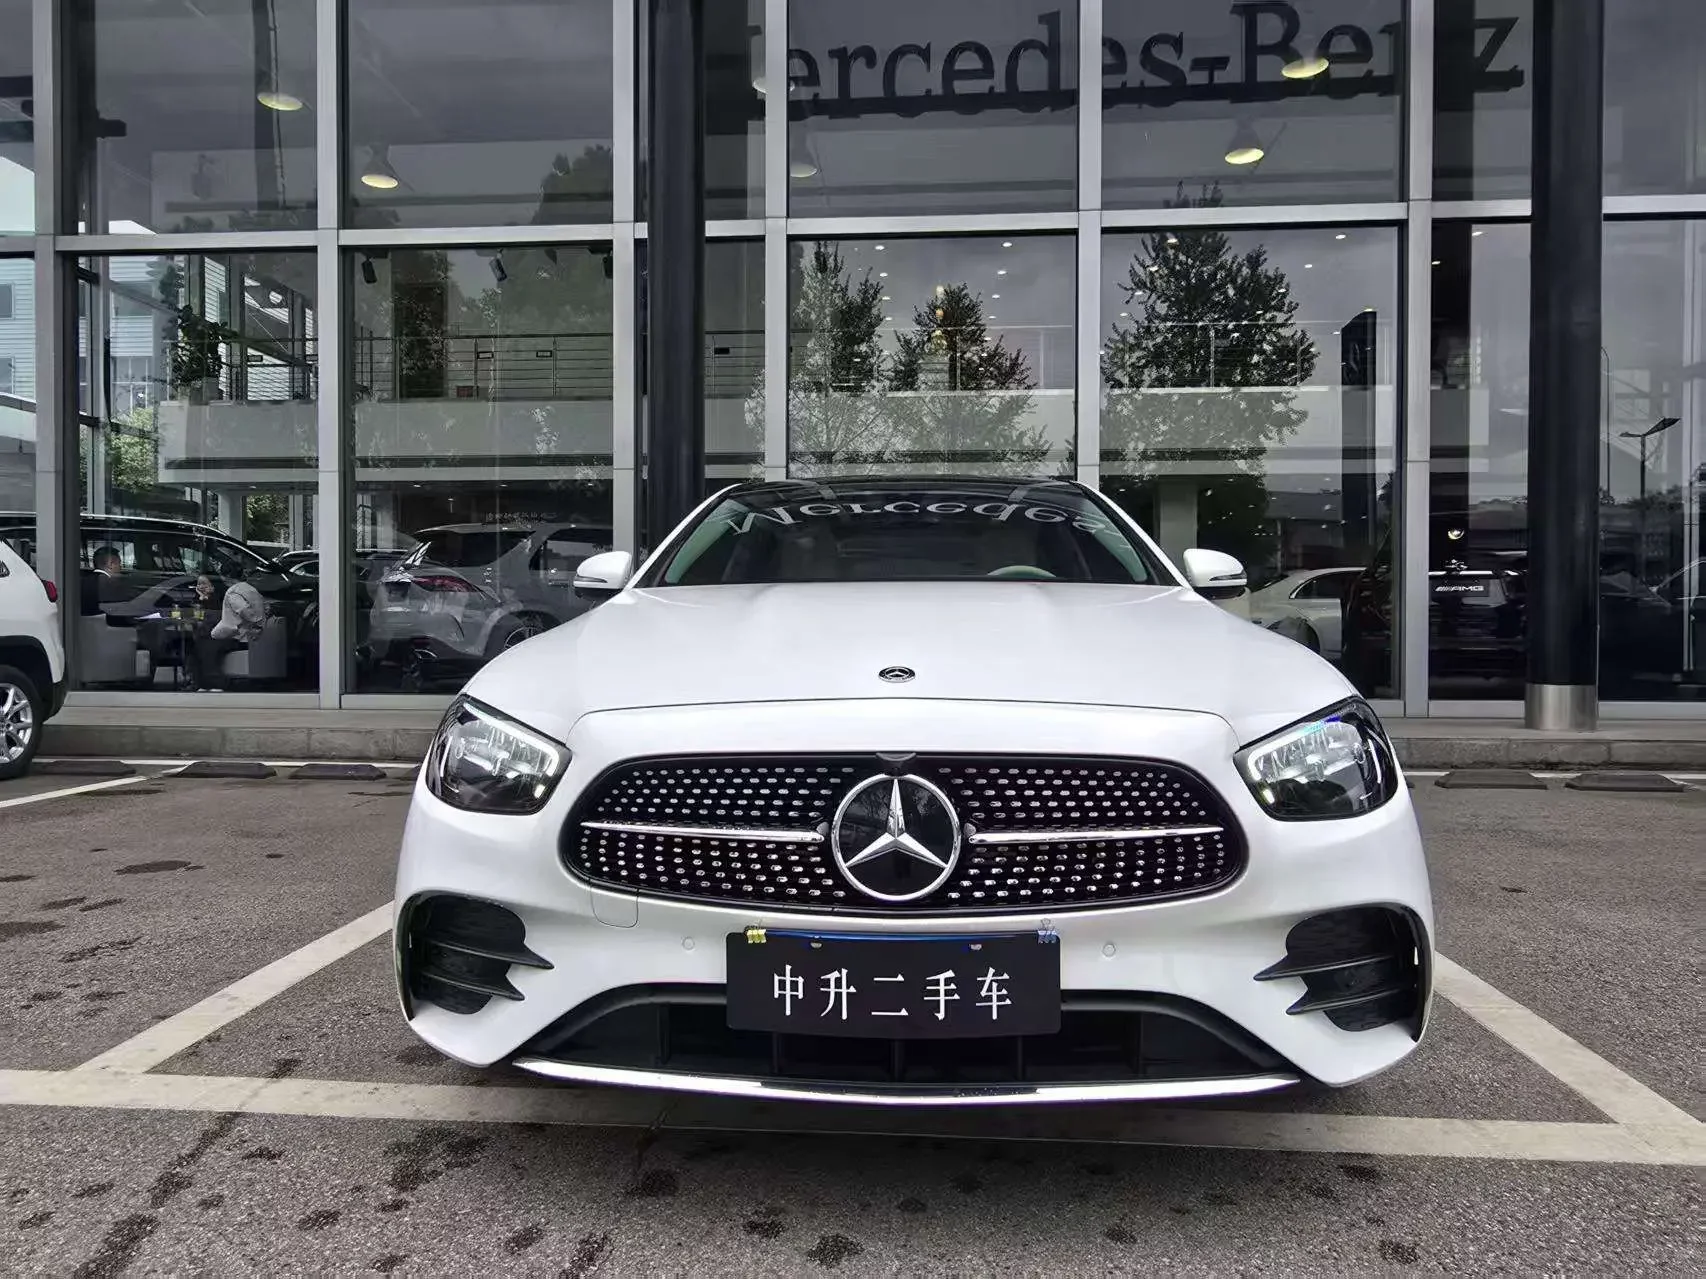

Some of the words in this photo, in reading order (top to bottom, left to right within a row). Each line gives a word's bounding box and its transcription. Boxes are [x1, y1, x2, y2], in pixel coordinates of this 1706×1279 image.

[772, 964, 1013, 1021] 中升二手车
